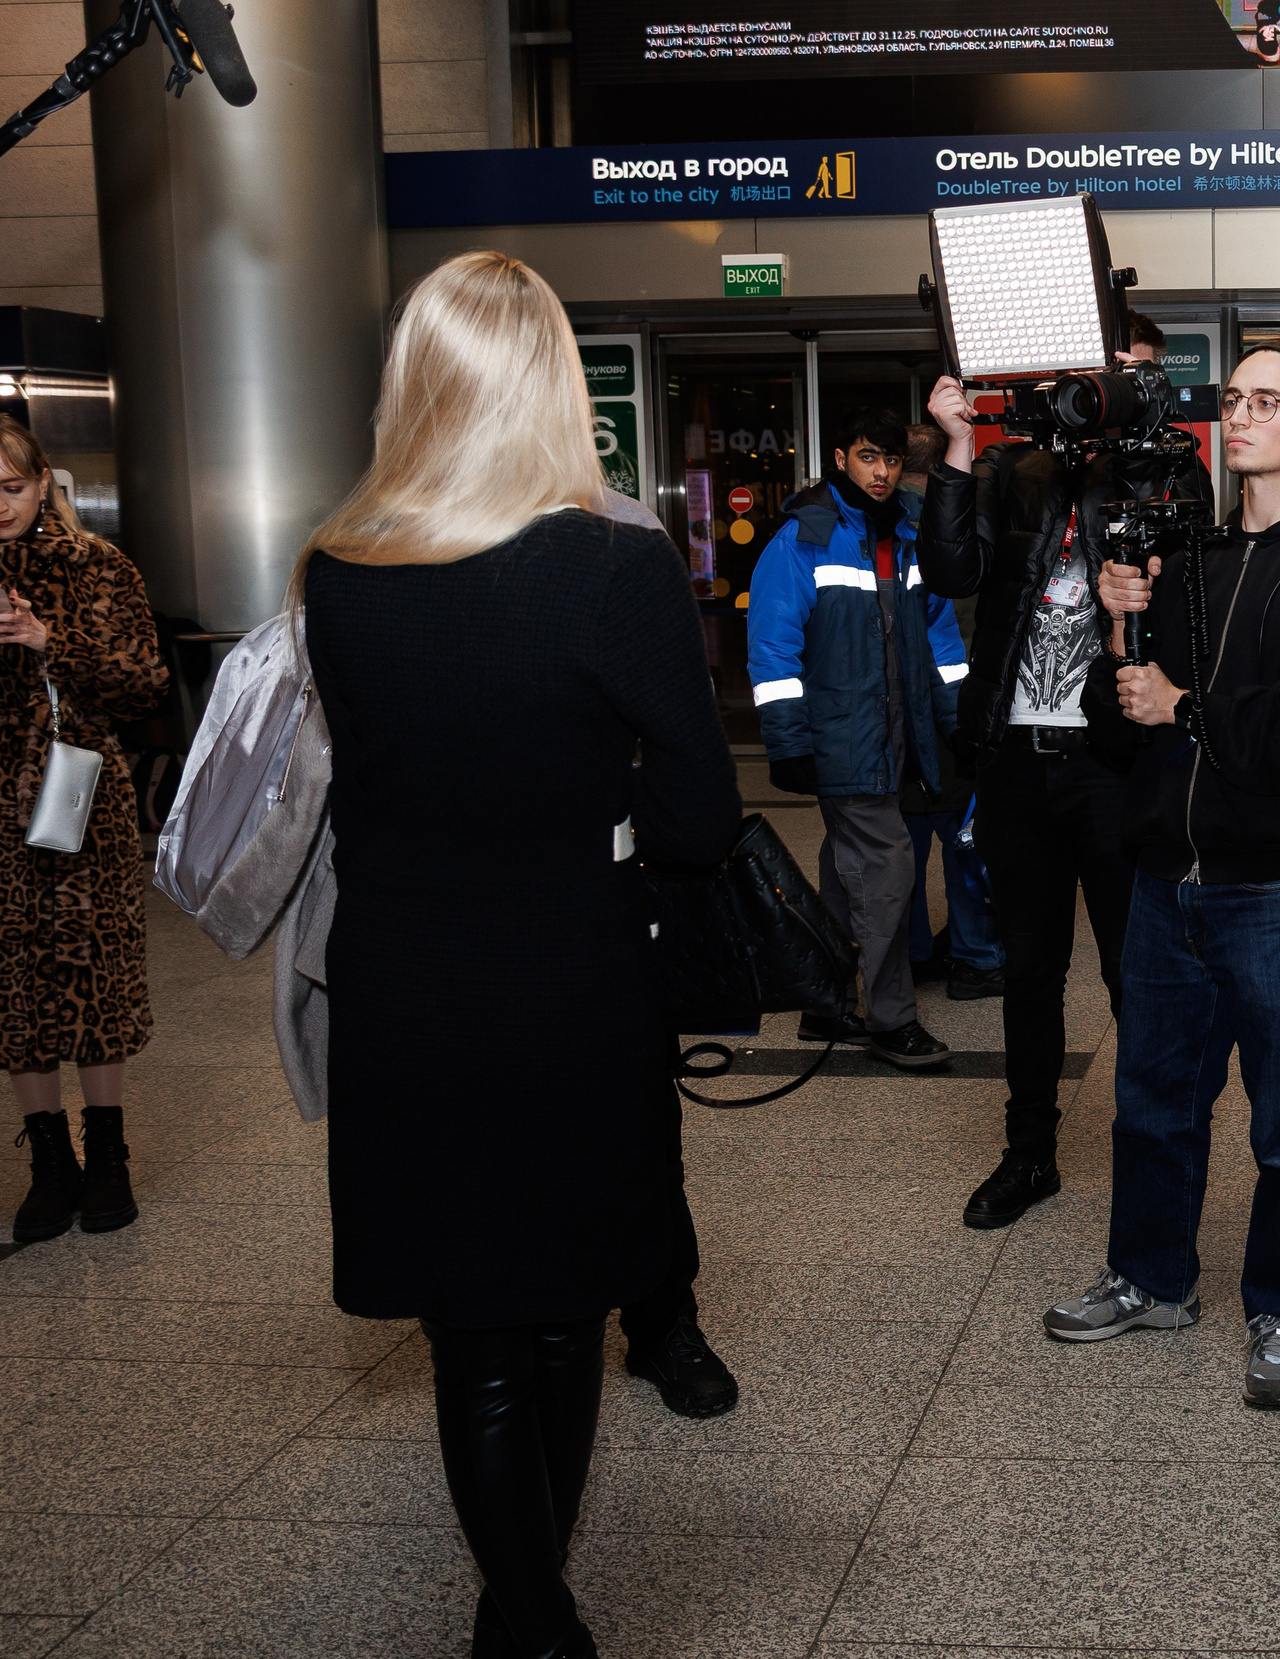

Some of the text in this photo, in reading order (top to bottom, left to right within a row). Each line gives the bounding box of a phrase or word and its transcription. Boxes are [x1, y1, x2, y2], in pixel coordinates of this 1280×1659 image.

[647, 22, 792, 34] КЭШБЭК ВЫДАЕТСЯ БОНУСАМИ
[729, 35, 743, 44] НА
[807, 31, 861, 43] ДЕЙСТВУЕТ
[862, 31, 877, 42] ДО
[920, 28, 992, 40] ПОДРОБНОСТИ
[993, 28, 1008, 37] НА
[1009, 26, 1040, 37] САЙТЕ
[1042, 26, 1109, 36] SUTOCHNO.RU
[644, 50, 657, 60] АО
[709, 48, 733, 57] ОГРН
[823, 43, 885, 54] УЛЬЯНОВСКАЯ
[936, 148, 1019, 171] Отель
[1026, 142, 1181, 169] DoubleTree
[1190, 142, 1222, 170] by
[592, 156, 789, 181] Выход в город
[594, 185, 720, 204] Exit to the city
[730, 185, 791, 202] 机场出口
[937, 175, 1181, 197] DoubleTree by Hilton hotel
[726, 268, 779, 285] ВЫХОД
[745, 286, 760, 295] EXIT
[1157, 354, 1201, 366] уково
